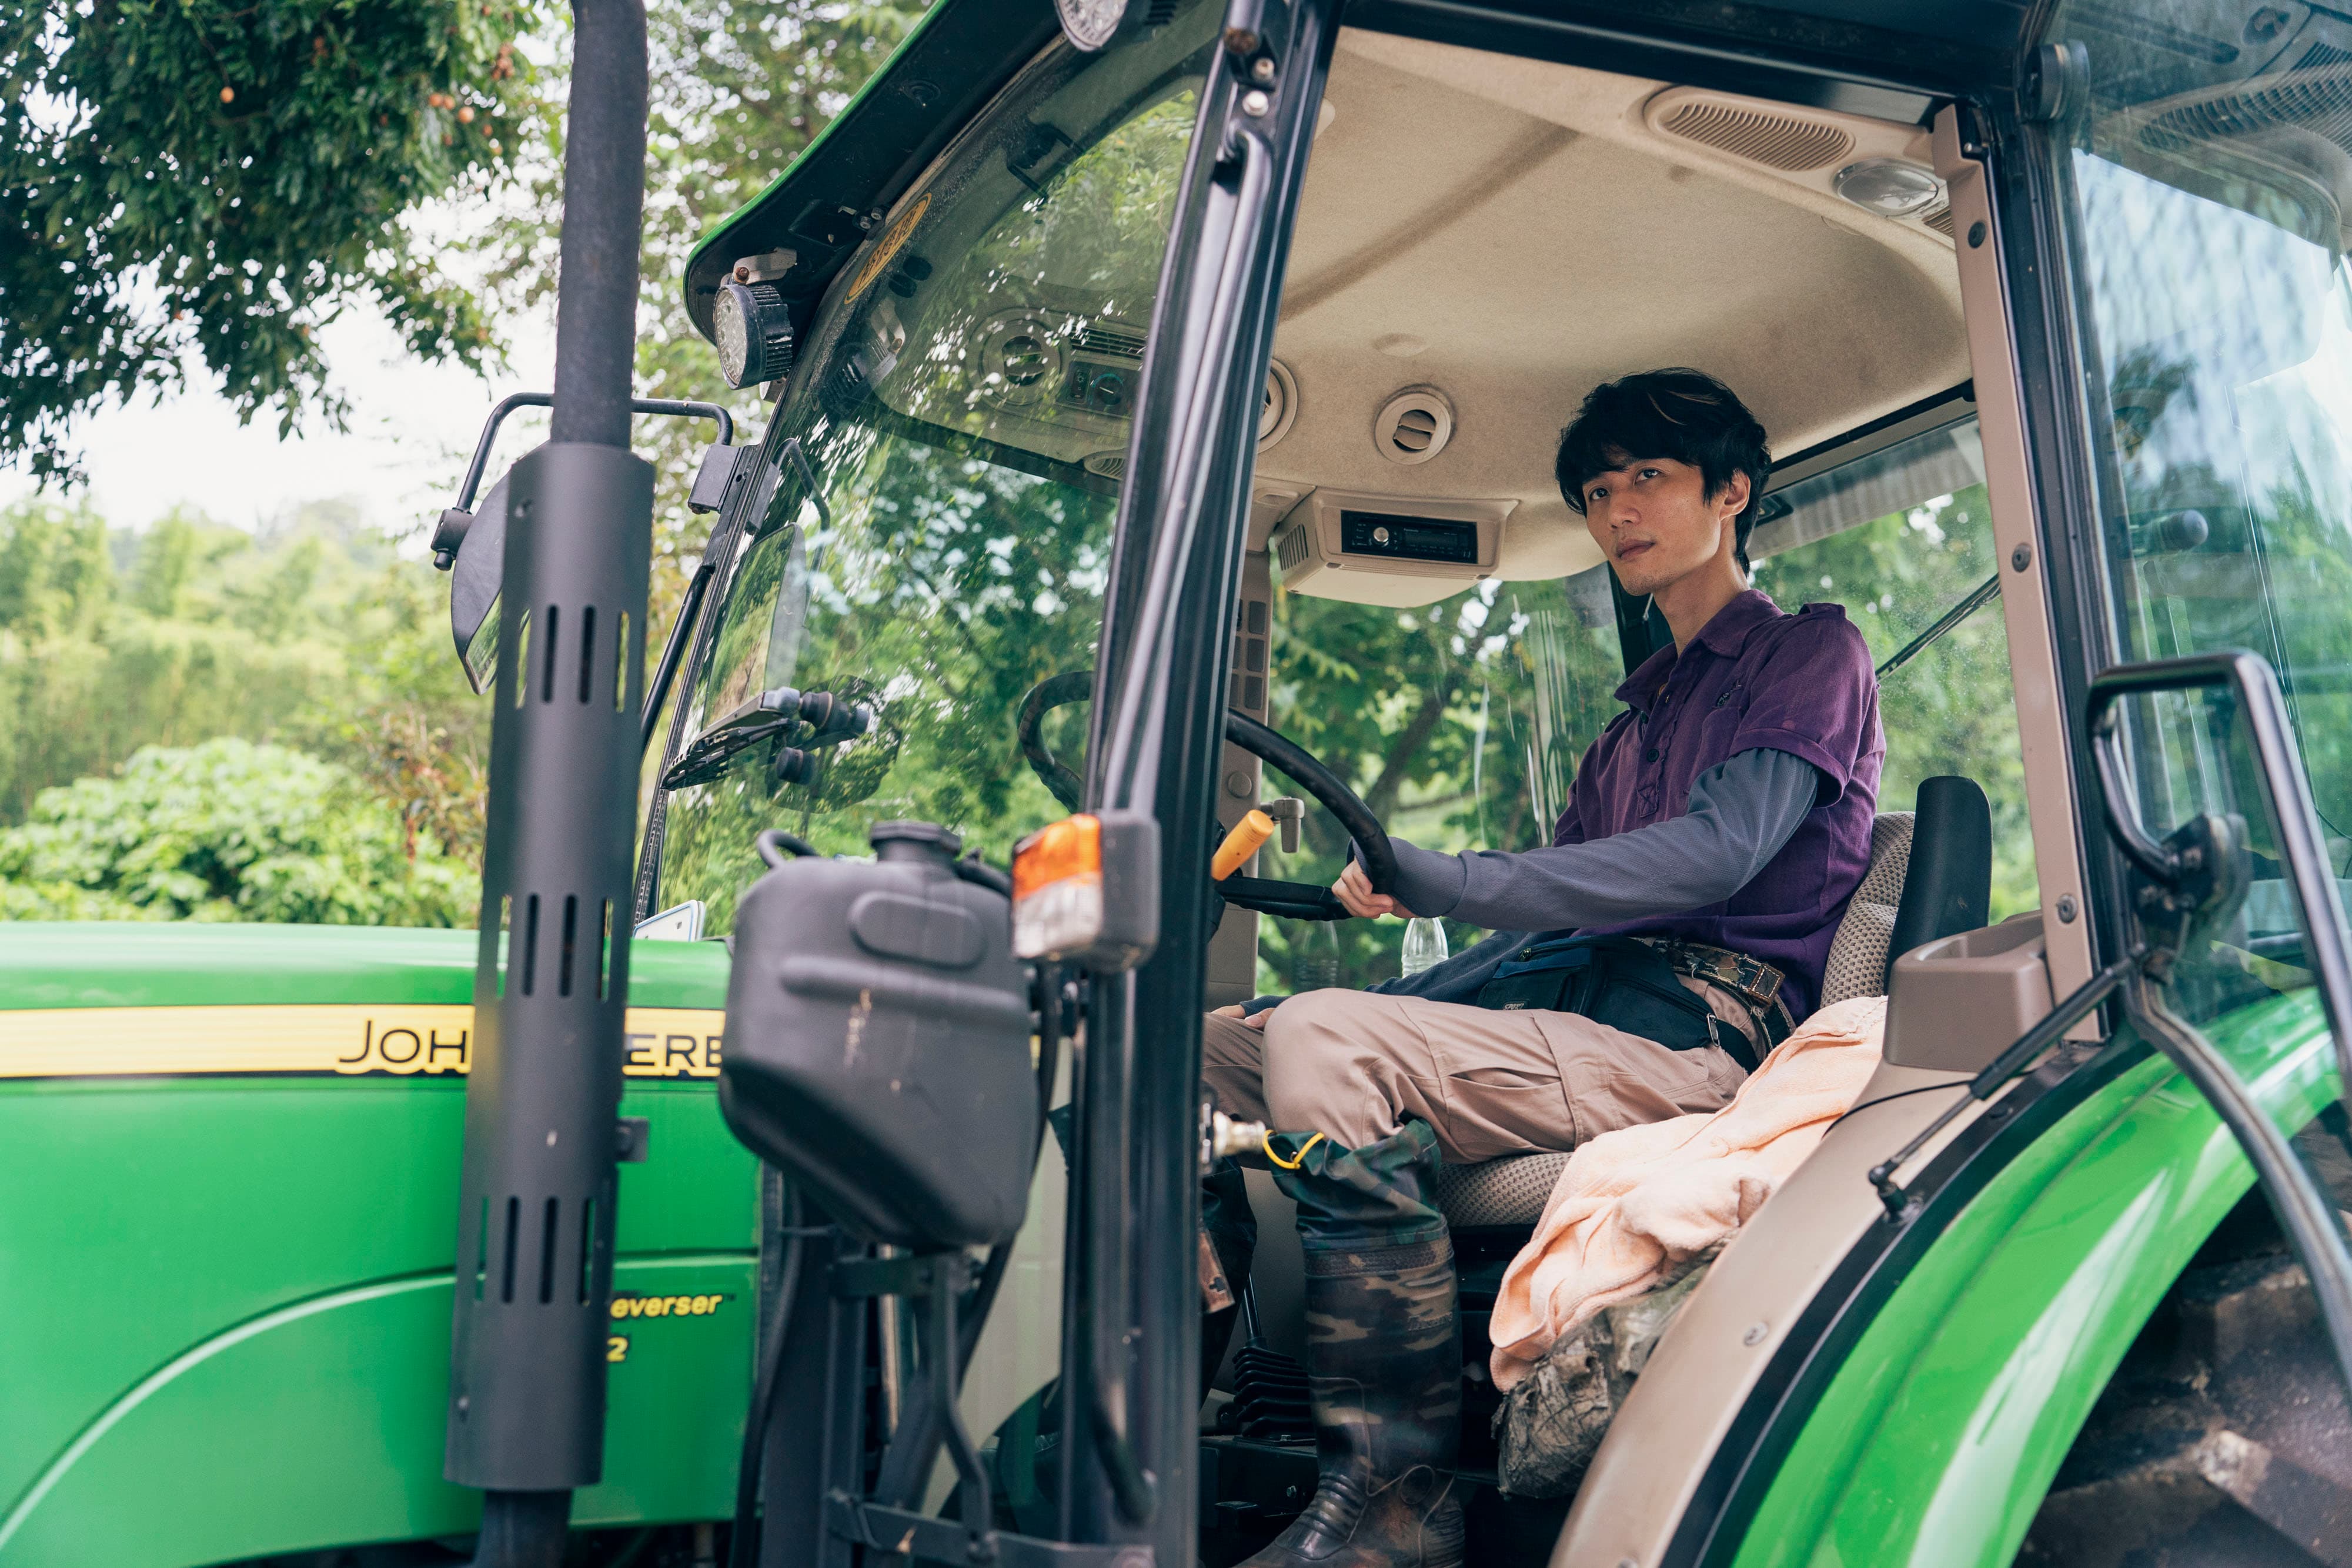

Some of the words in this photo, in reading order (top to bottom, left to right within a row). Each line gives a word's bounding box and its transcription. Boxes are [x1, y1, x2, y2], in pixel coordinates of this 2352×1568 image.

[339, 1020, 466, 1063] JOH
[626, 1034, 722, 1067] ERE
[610, 1295, 723, 1319] everser
